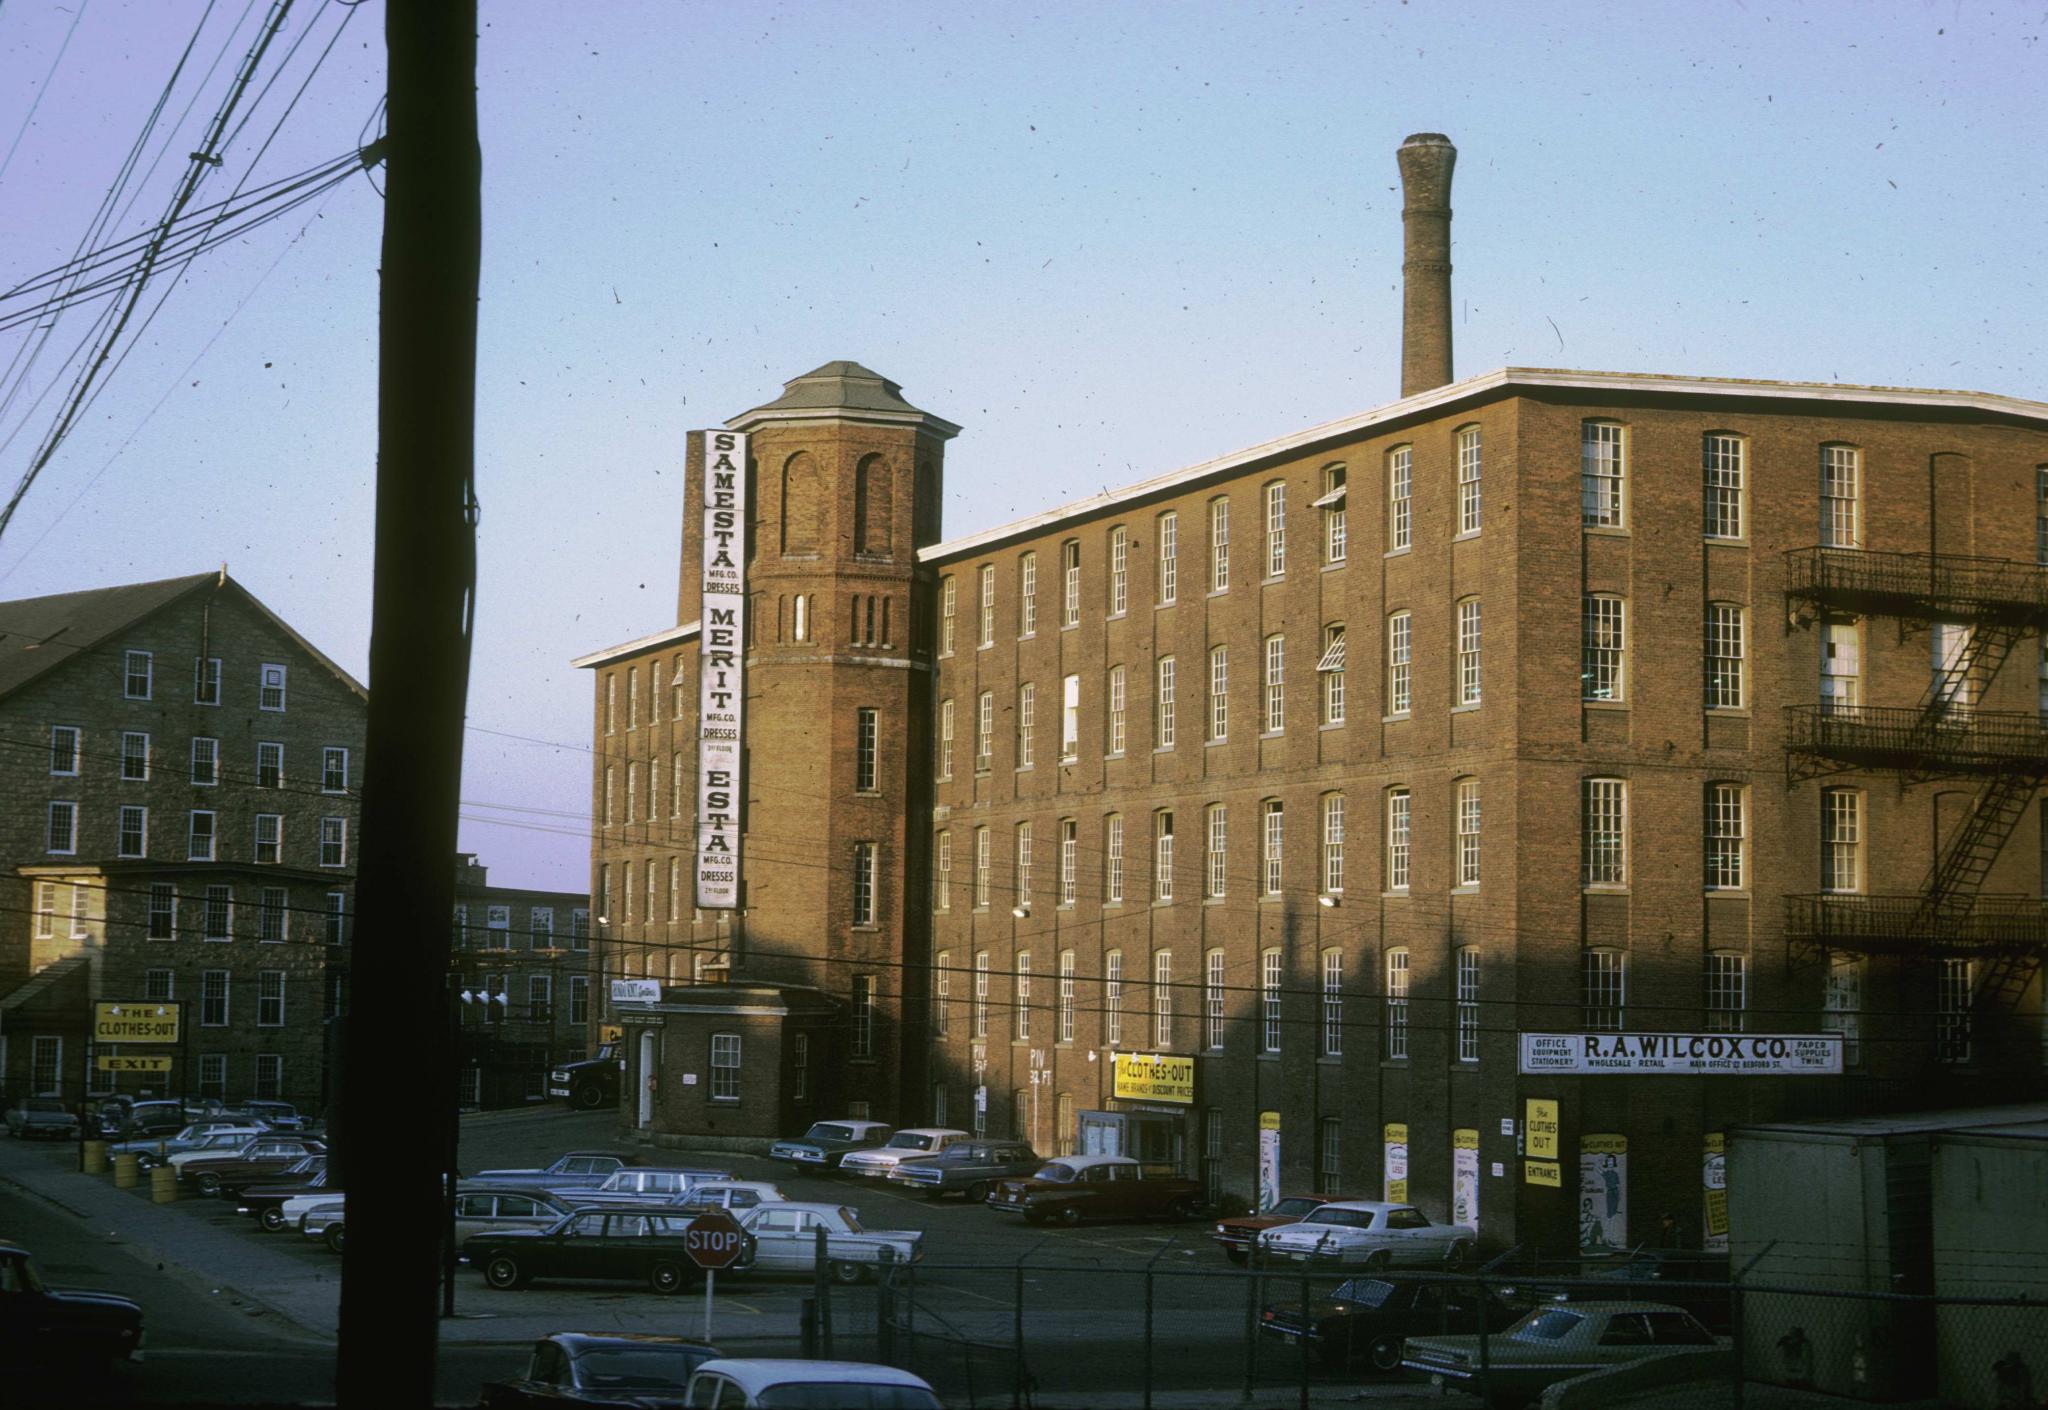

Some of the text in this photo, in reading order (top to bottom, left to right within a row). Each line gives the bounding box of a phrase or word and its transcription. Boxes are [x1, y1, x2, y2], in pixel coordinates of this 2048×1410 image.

[712, 433, 736, 567] SAMESTA
[706, 582, 740, 593] DRESSES
[710, 608, 736, 709] MERIT
[704, 728, 737, 739] DRESSES
[705, 770, 730, 852] ESTA
[701, 870, 734, 882] DRESSES
[119, 1009, 153, 1018] THE
[98, 1022, 176, 1036] CLOTHES-OUT
[1536, 1039, 1567, 1048] OFFICE
[1752, 1038, 1791, 1059] CO.
[1797, 1041, 1826, 1049] PAPER
[1795, 1049, 1831, 1057] SUPPLIES
[108, 1059, 163, 1069] EXIT
[1531, 1057, 1574, 1066] STATIONERY
[1588, 1059, 1632, 1068] WHOLESALE
[1638, 1059, 1665, 1068] RETAIL
[1708, 1060, 1731, 1068] OFFICE
[1801, 1057, 1824, 1065] TWINE
[1127, 1061, 1191, 1082] CLOTHES-OUT
[1529, 1120, 1557, 1133] CLOTHES
[1533, 1137, 1551, 1149] OUT
[1528, 1166, 1558, 1179] ENTRANCE
[688, 1230, 738, 1251] STOP
